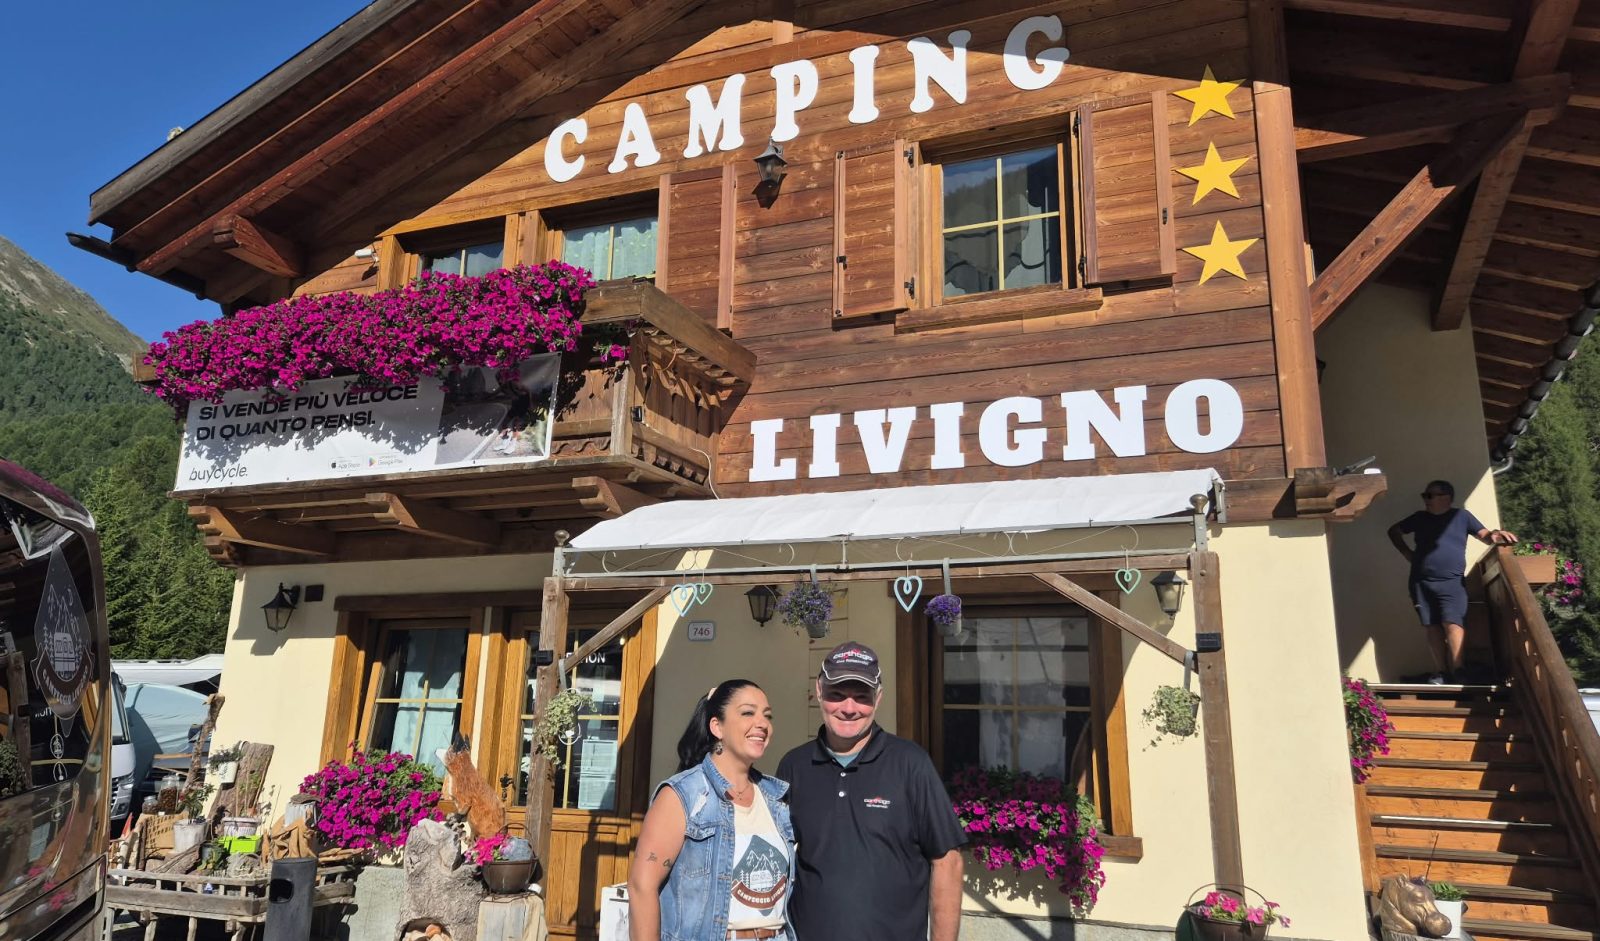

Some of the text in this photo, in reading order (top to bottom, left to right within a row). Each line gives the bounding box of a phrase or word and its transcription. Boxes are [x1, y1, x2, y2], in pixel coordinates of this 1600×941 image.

[544, 15, 1070, 182] CAMPING
[199, 384, 418, 420] SI VENDE PIÙ VELOCE
[196, 411, 376, 441] DI QUANTO PENSI.
[749, 378, 1244, 482] LIVIGNO
[693, 627, 710, 636] 746
